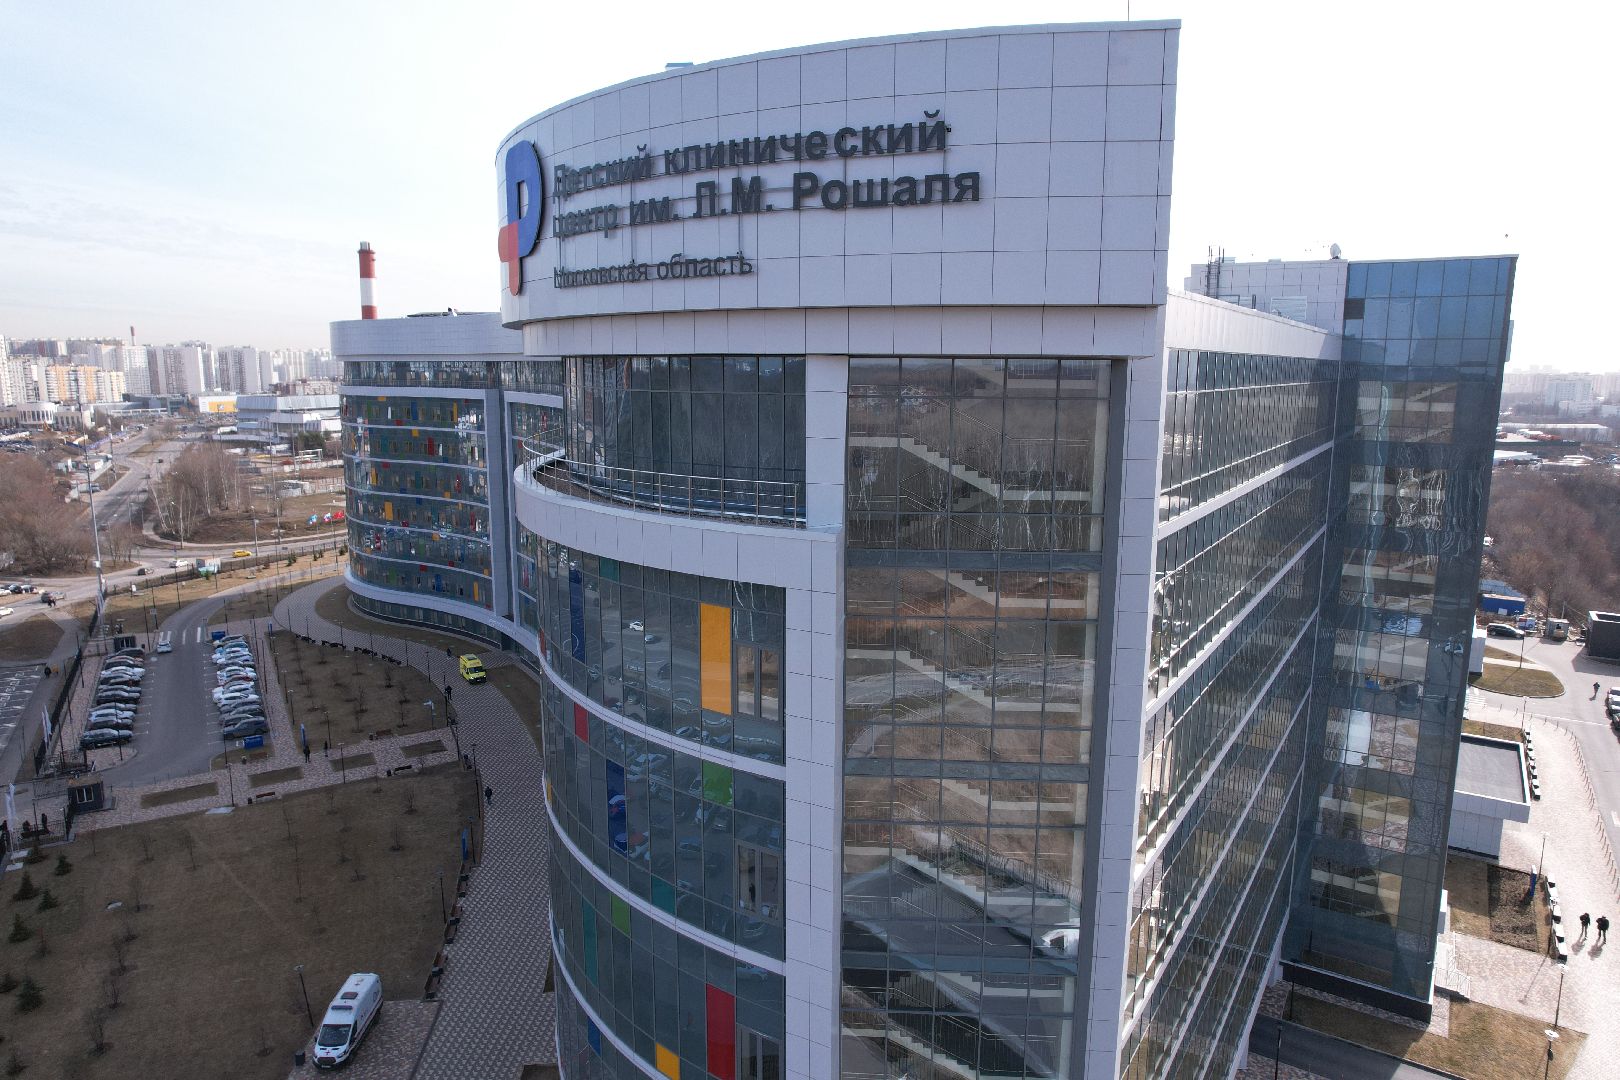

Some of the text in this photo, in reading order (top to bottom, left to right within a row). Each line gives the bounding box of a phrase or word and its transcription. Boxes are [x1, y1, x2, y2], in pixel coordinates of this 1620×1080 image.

[553, 109, 946, 203] Детский клинический
[553, 172, 980, 240] центр им. Л.М. Рошаля
[554, 253, 753, 288] Московская область
